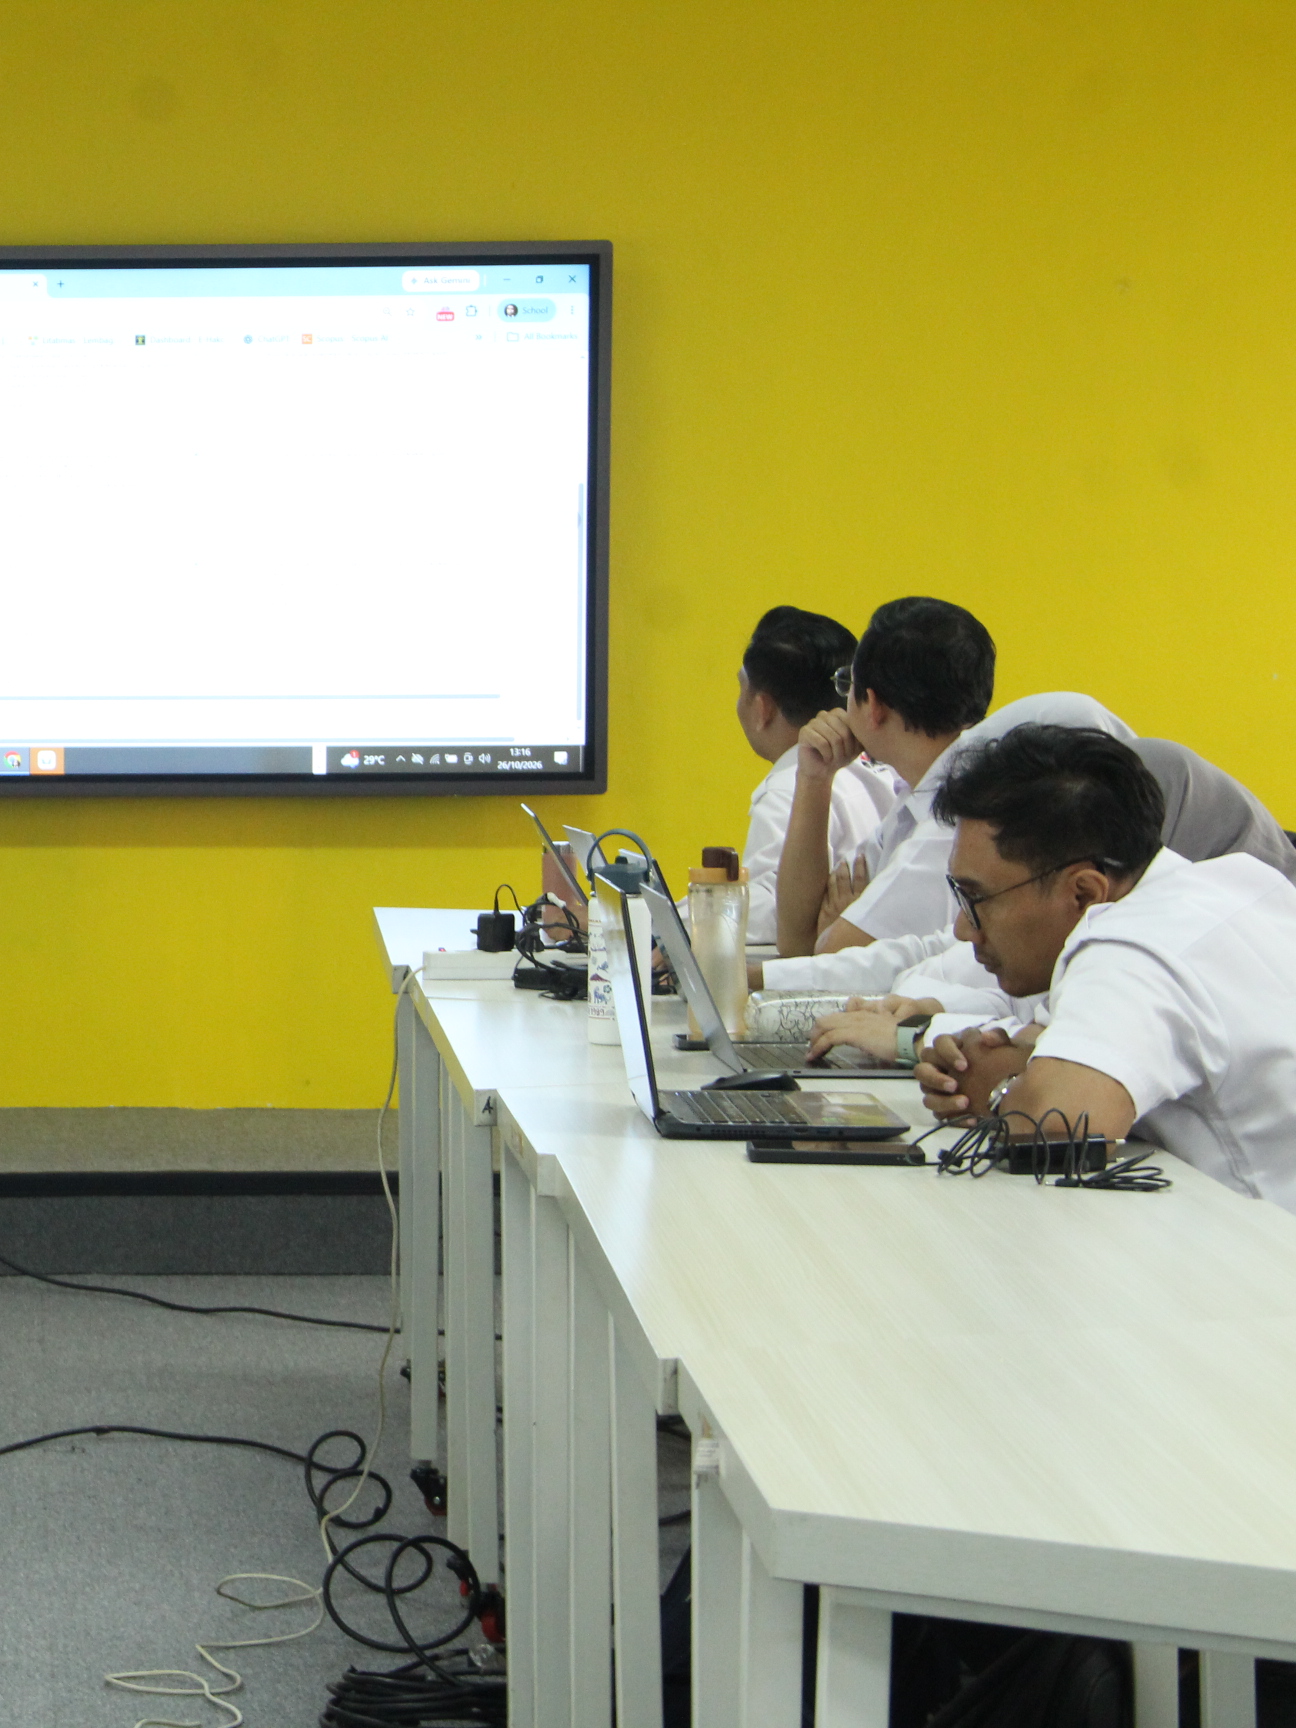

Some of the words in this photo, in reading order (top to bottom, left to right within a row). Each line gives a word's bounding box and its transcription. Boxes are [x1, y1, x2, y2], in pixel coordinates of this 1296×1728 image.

[423, 276, 438, 284] Ask
[522, 306, 549, 315] School
[150, 335, 191, 344] Dashboard
[258, 335, 290, 343] ChatGPT
[524, 332, 534, 340] All
[536, 332, 578, 340] Bookmarks
[509, 748, 532, 757] 13:16
[363, 755, 385, 765] 29°C
[497, 760, 544, 771] 26/10/2026
